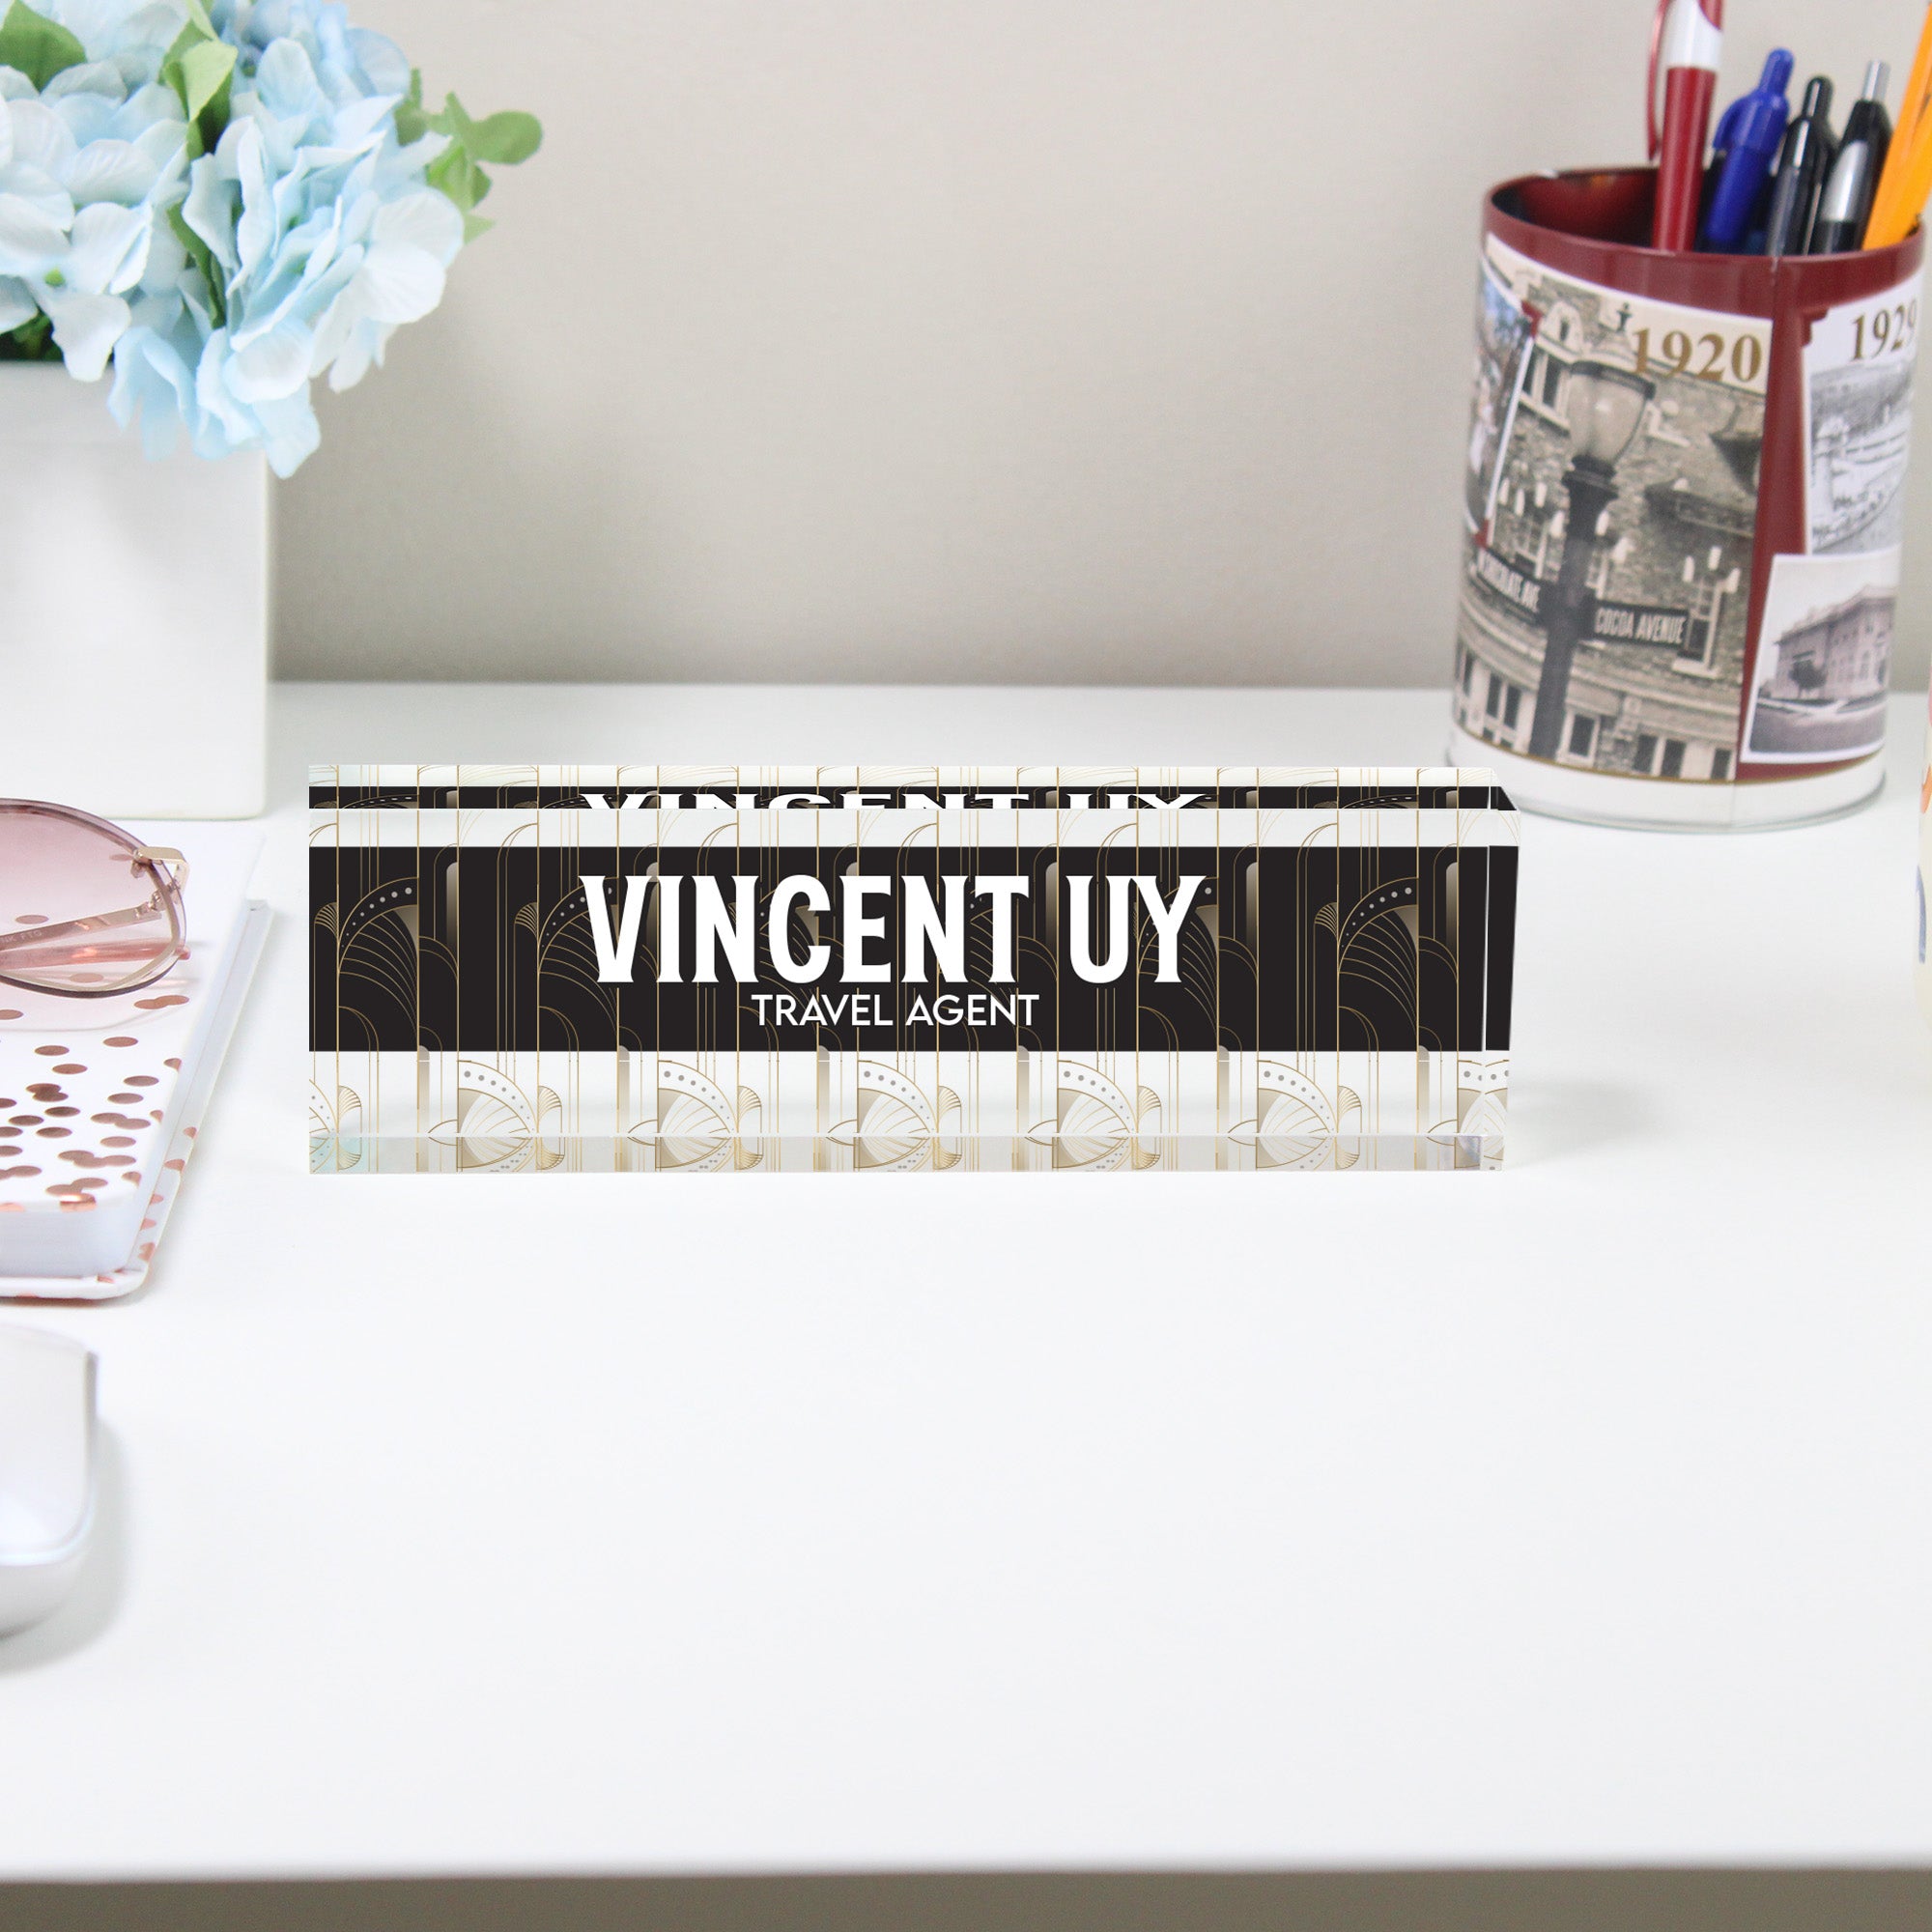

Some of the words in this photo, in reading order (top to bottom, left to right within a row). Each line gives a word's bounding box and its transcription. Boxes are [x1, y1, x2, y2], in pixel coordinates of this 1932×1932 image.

[1633, 327, 1762, 383] 1920
[1850, 298, 1917, 362] 1929
[1594, 607, 1634, 639] COCOA
[1635, 613, 1687, 644] AVENUE
[580, 874, 1029, 983] VINCENT
[1066, 875, 1207, 983] UY
[751, 994, 894, 1026] TRAVEL
[905, 994, 1039, 1026] AGENT
